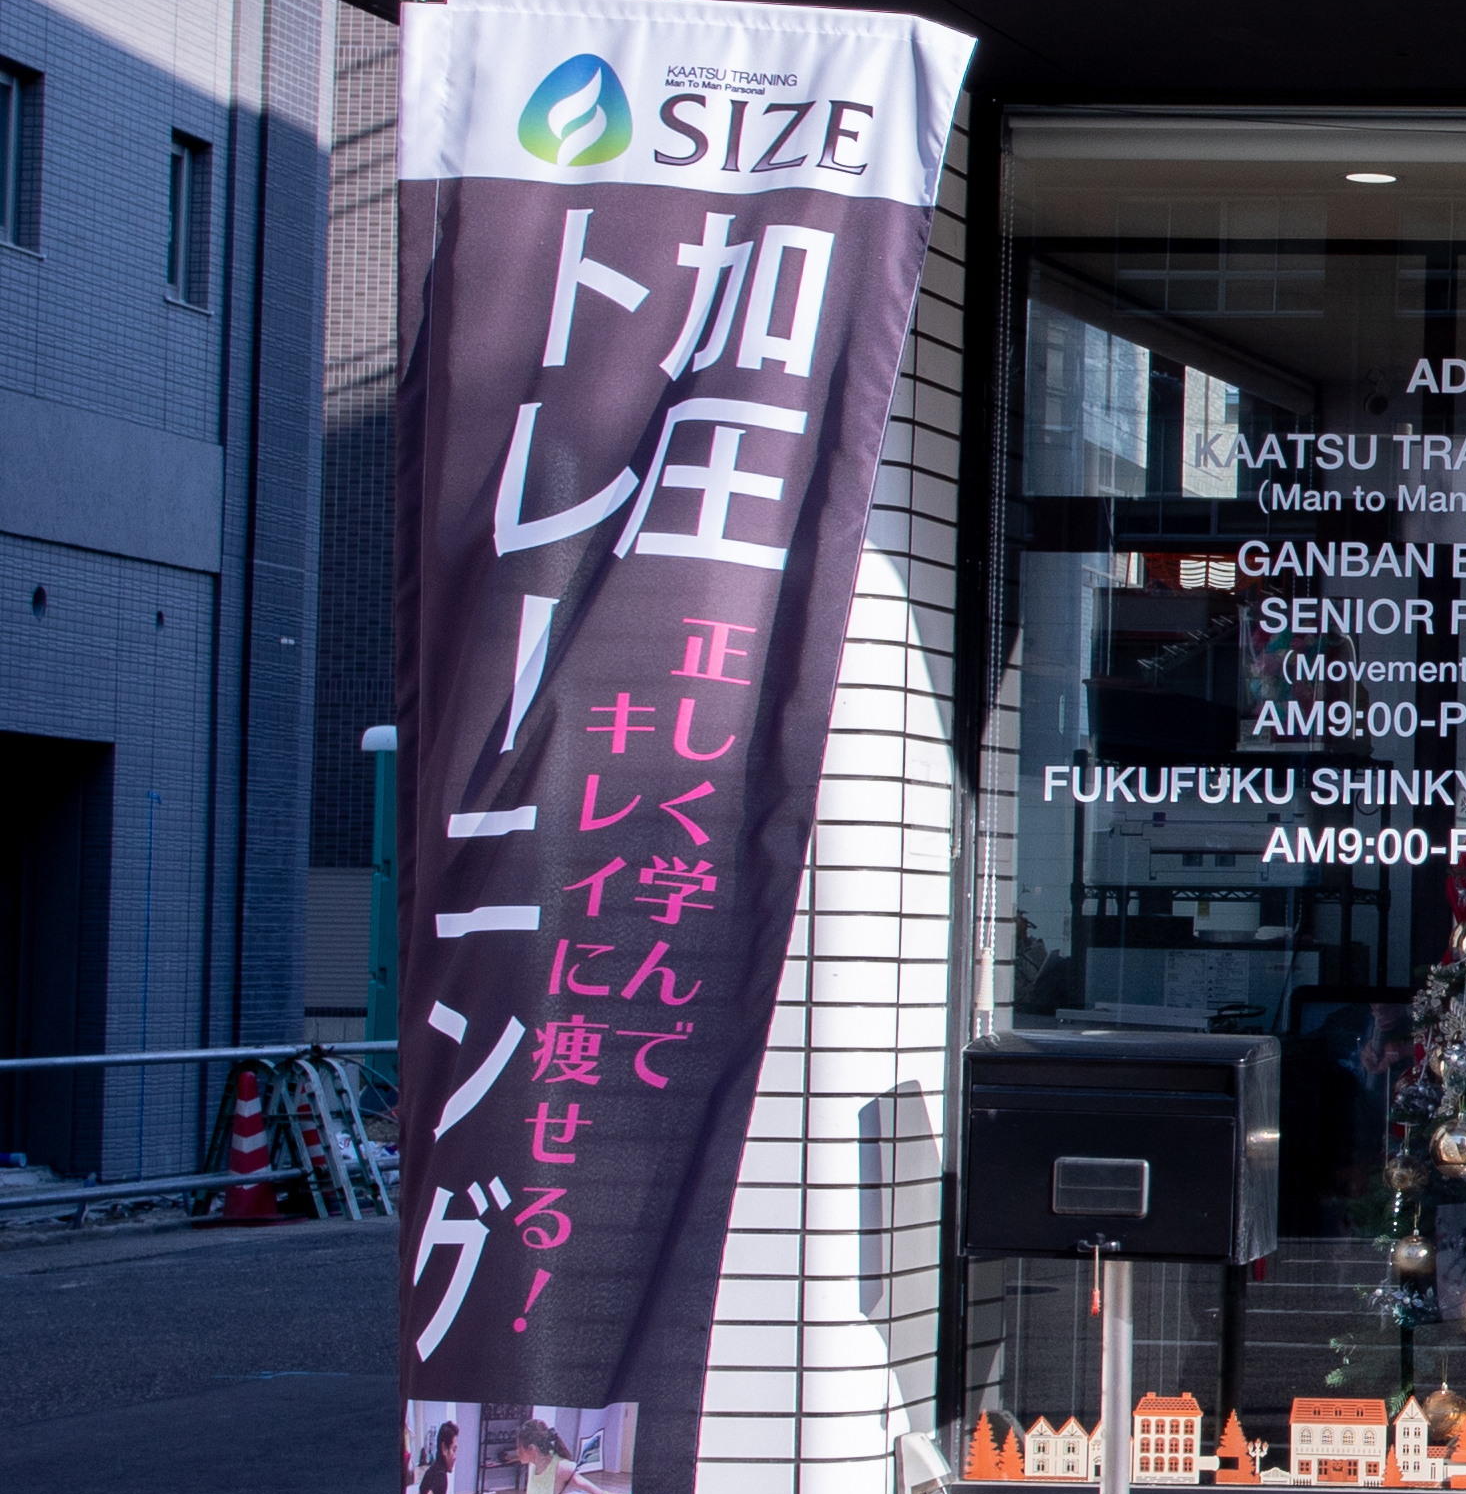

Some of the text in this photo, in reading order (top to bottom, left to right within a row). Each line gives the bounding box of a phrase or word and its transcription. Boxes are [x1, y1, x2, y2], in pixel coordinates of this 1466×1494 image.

[664, 78, 766, 96] Man To Man Parsonal
[666, 65, 798, 88] KAATSU TRAINING
[653, 93, 875, 176] SIZE
[611, 210, 836, 572] 加圧
[1194, 433, 1380, 472] KAATSU
[1257, 482, 1346, 516] (Man
[1353, 487, 1385, 513] to
[1237, 541, 1435, 580] GANBAN
[1258, 598, 1435, 637] SENIOR
[413, 207, 651, 1364] トレーニング
[1043, 765, 1298, 805] FUKUFUKU
[614, 616, 759, 1091] 正しく学んで
[513, 691, 657, 1335] キレイに痩せる！
